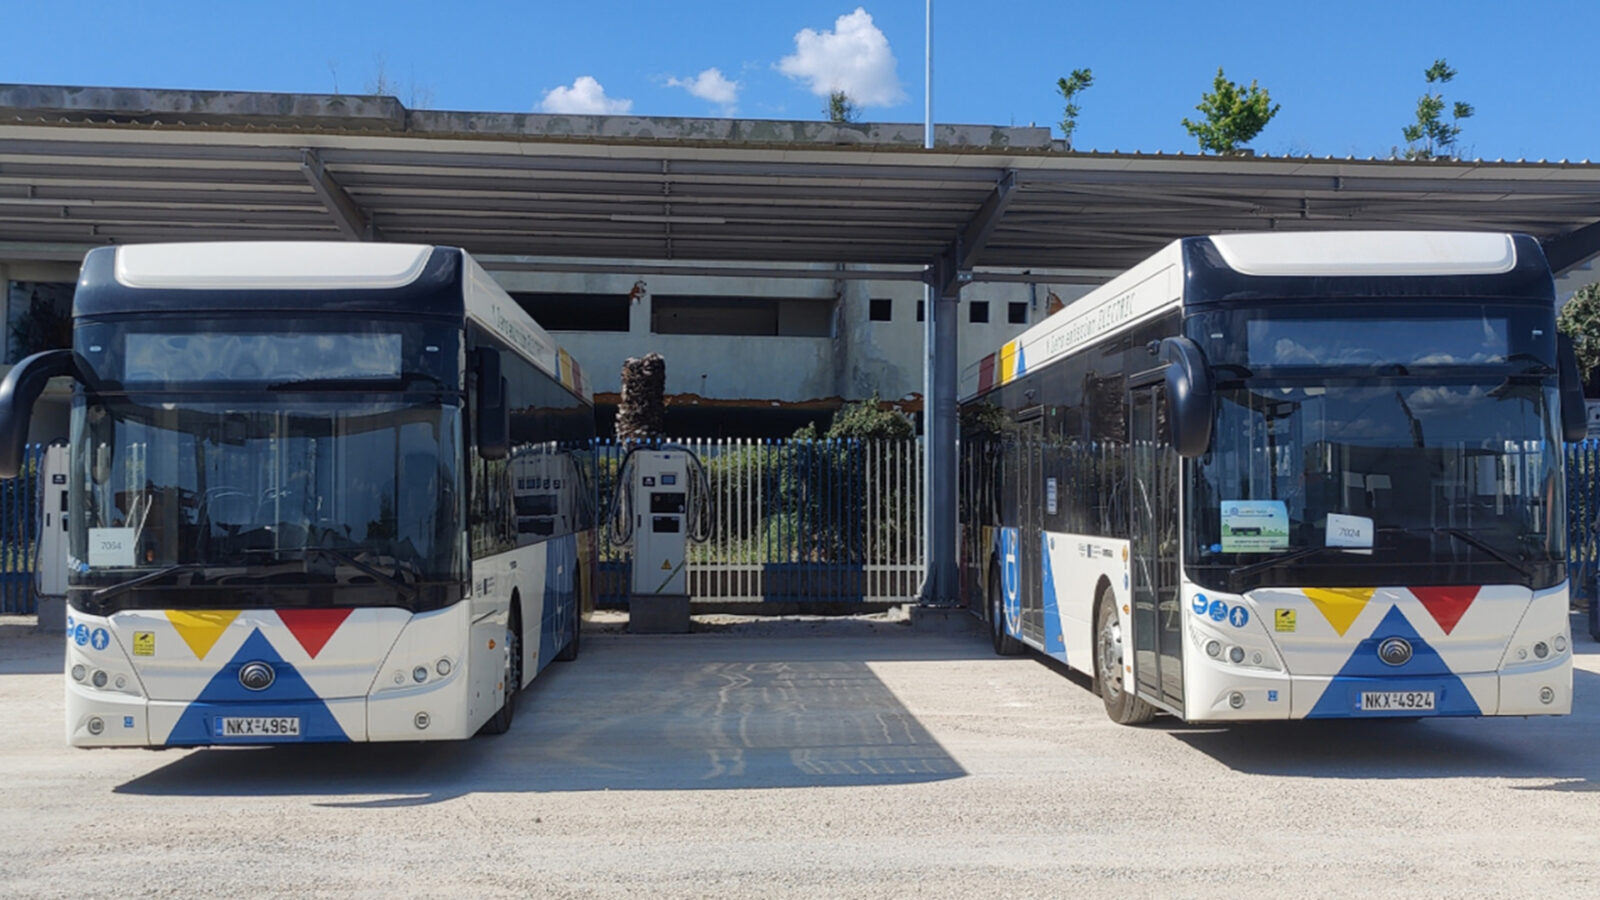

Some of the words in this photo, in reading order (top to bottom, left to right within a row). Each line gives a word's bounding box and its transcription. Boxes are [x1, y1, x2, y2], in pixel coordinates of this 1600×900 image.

[1338, 526, 1361, 538] 7024
[1365, 692, 1432, 709] NKX-4924
[226, 718, 297, 734] NKX-4964
